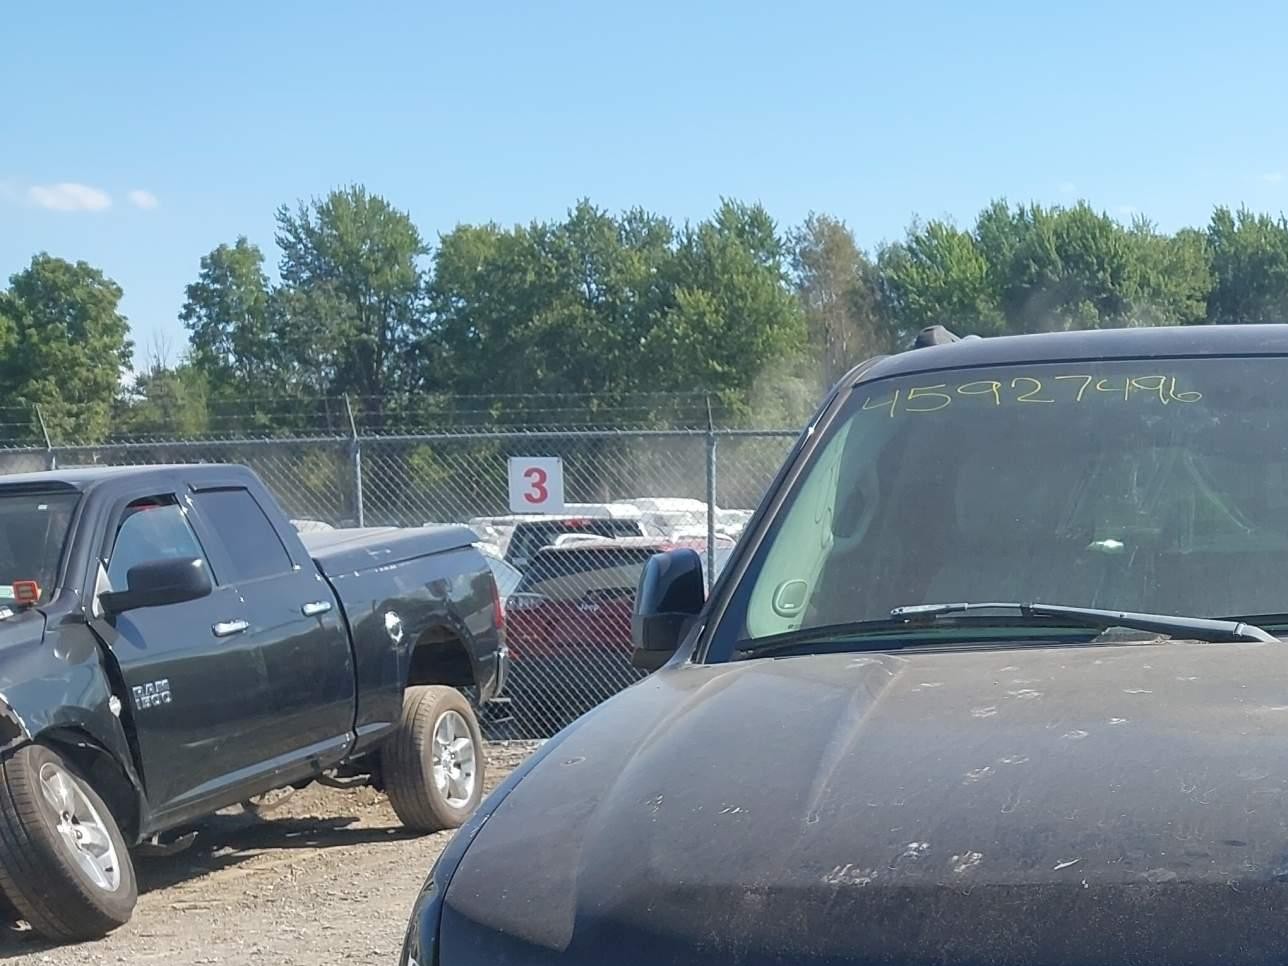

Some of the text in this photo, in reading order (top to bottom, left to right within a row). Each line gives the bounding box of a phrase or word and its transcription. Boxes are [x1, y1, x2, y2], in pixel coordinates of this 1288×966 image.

[862, 374, 1203, 418] 45927496
[523, 467, 548, 504] 3
[132, 679, 170, 702] RAM
[134, 690, 173, 710] 1500
